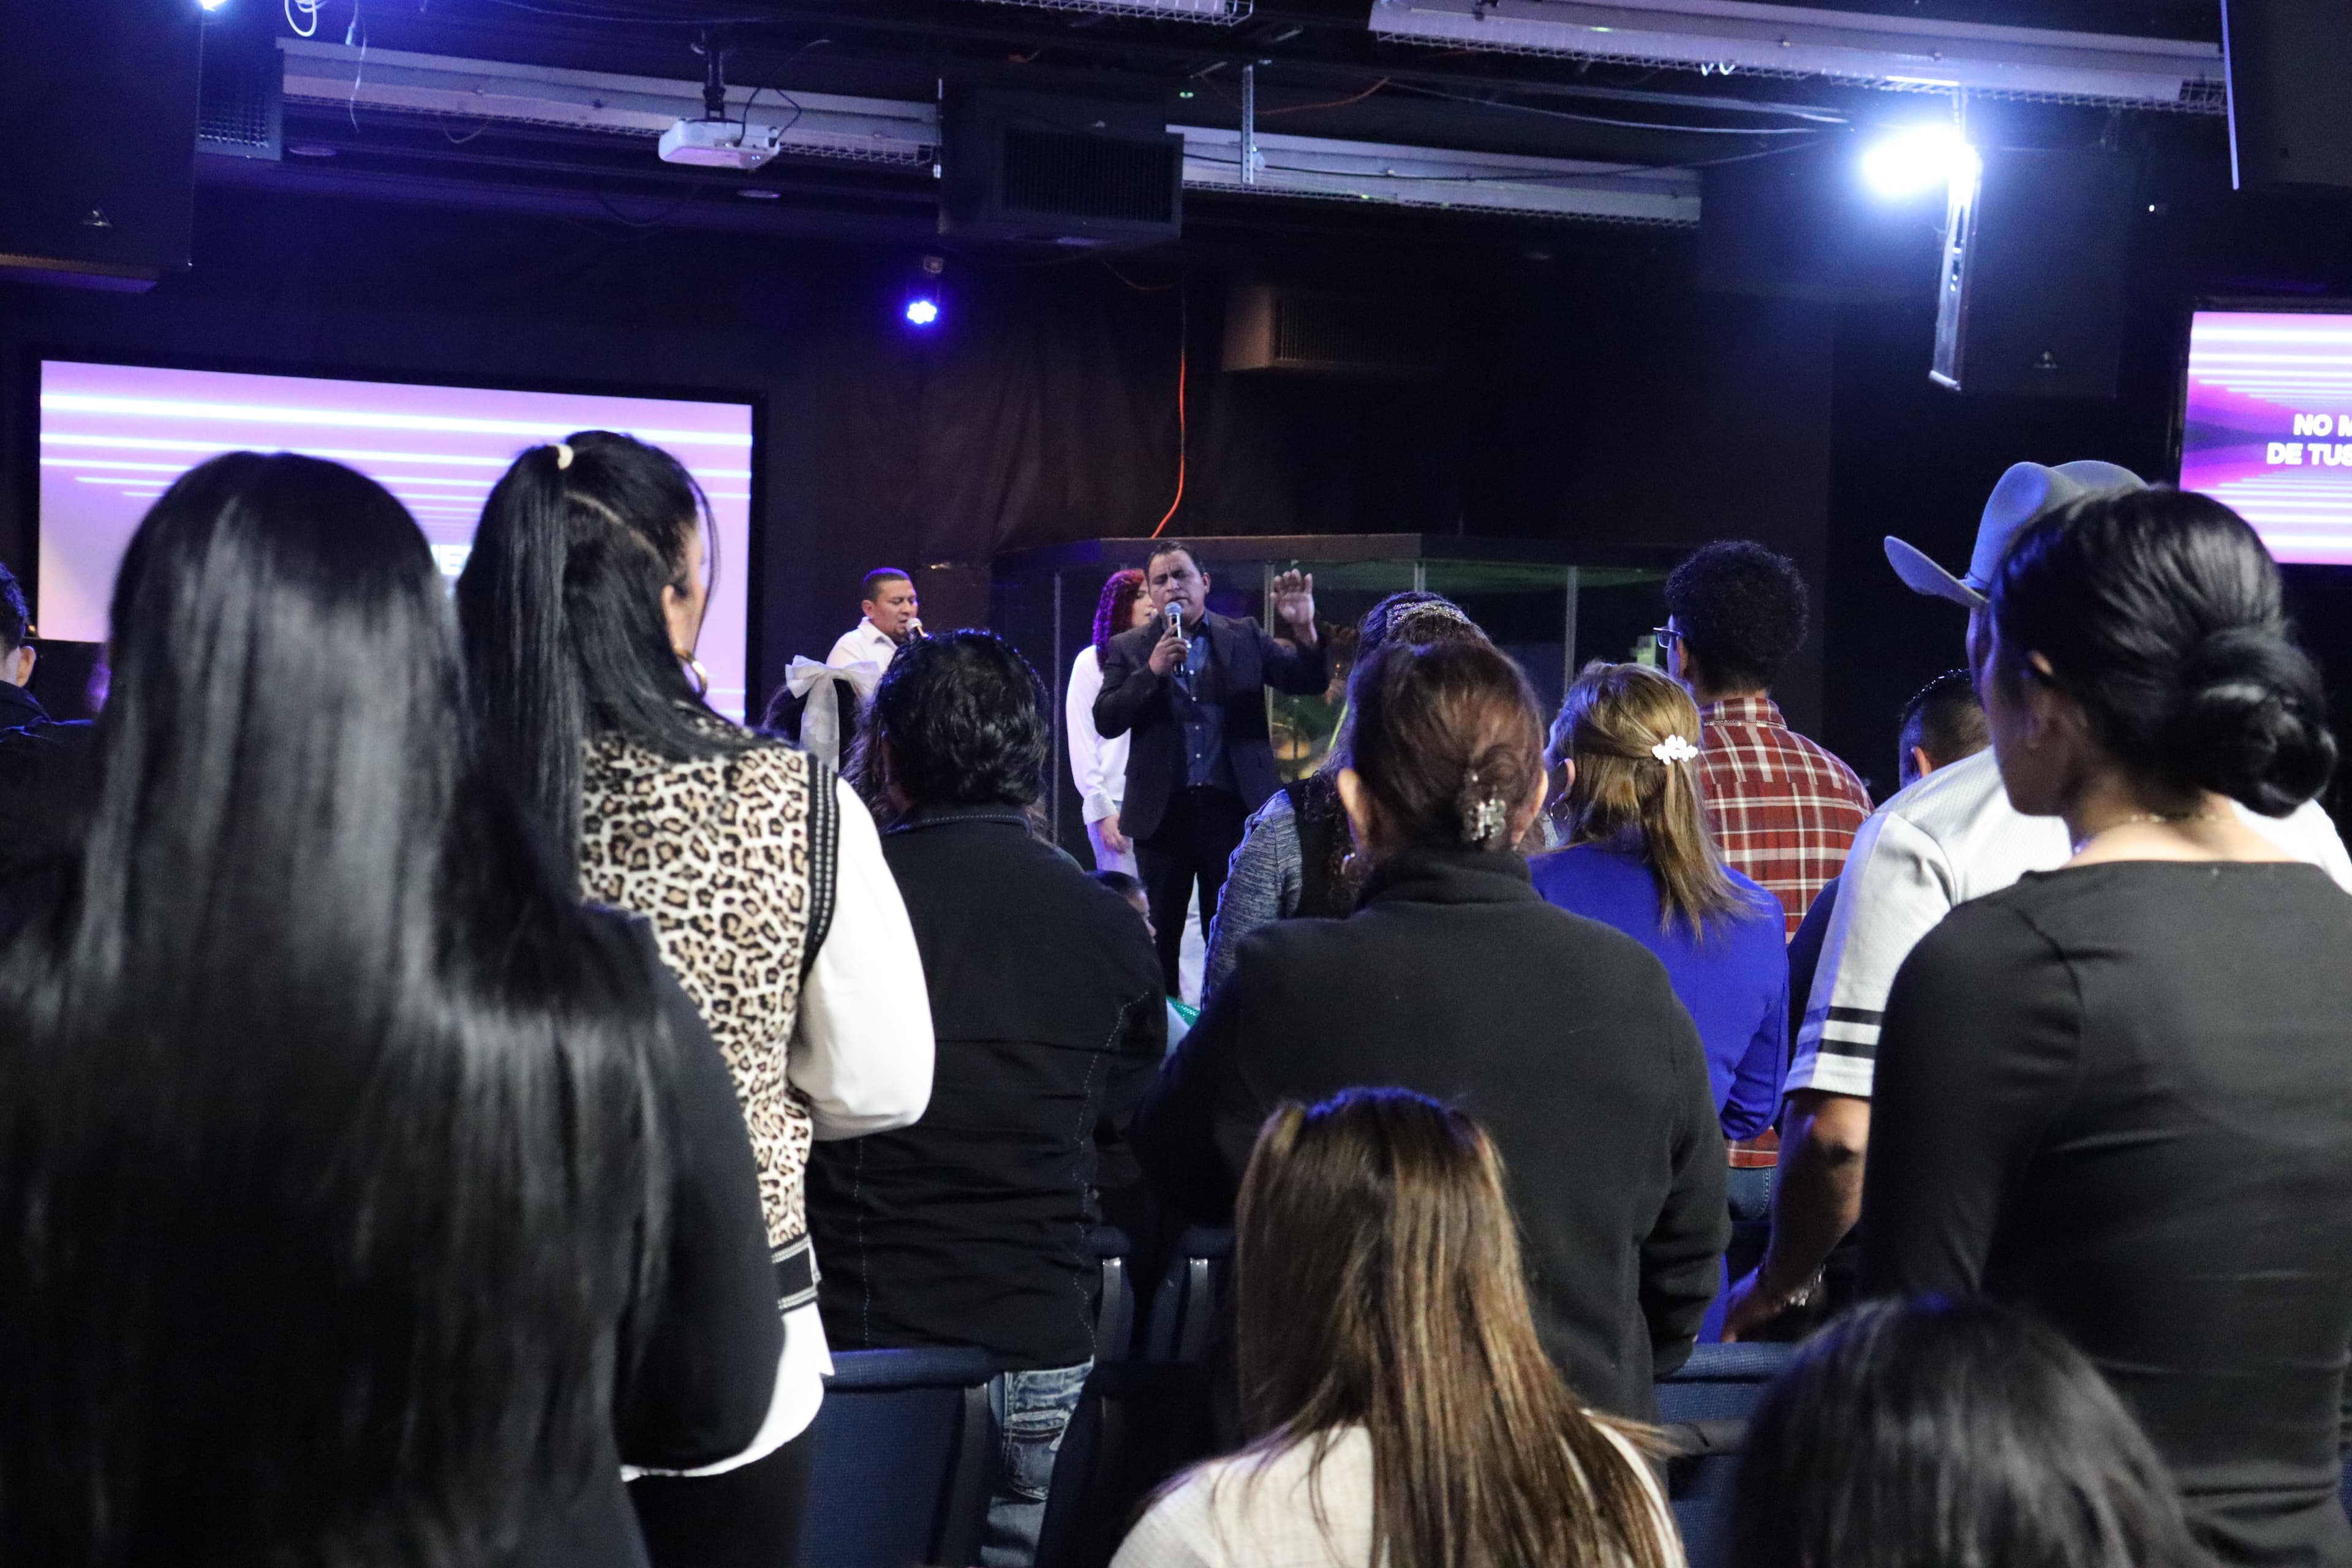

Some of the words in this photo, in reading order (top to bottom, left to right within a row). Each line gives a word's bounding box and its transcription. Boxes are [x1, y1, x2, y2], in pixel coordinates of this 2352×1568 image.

[2293, 413, 2333, 436] NO
[2266, 442, 2303, 465] DE
[2307, 443, 2352, 466] TUS
